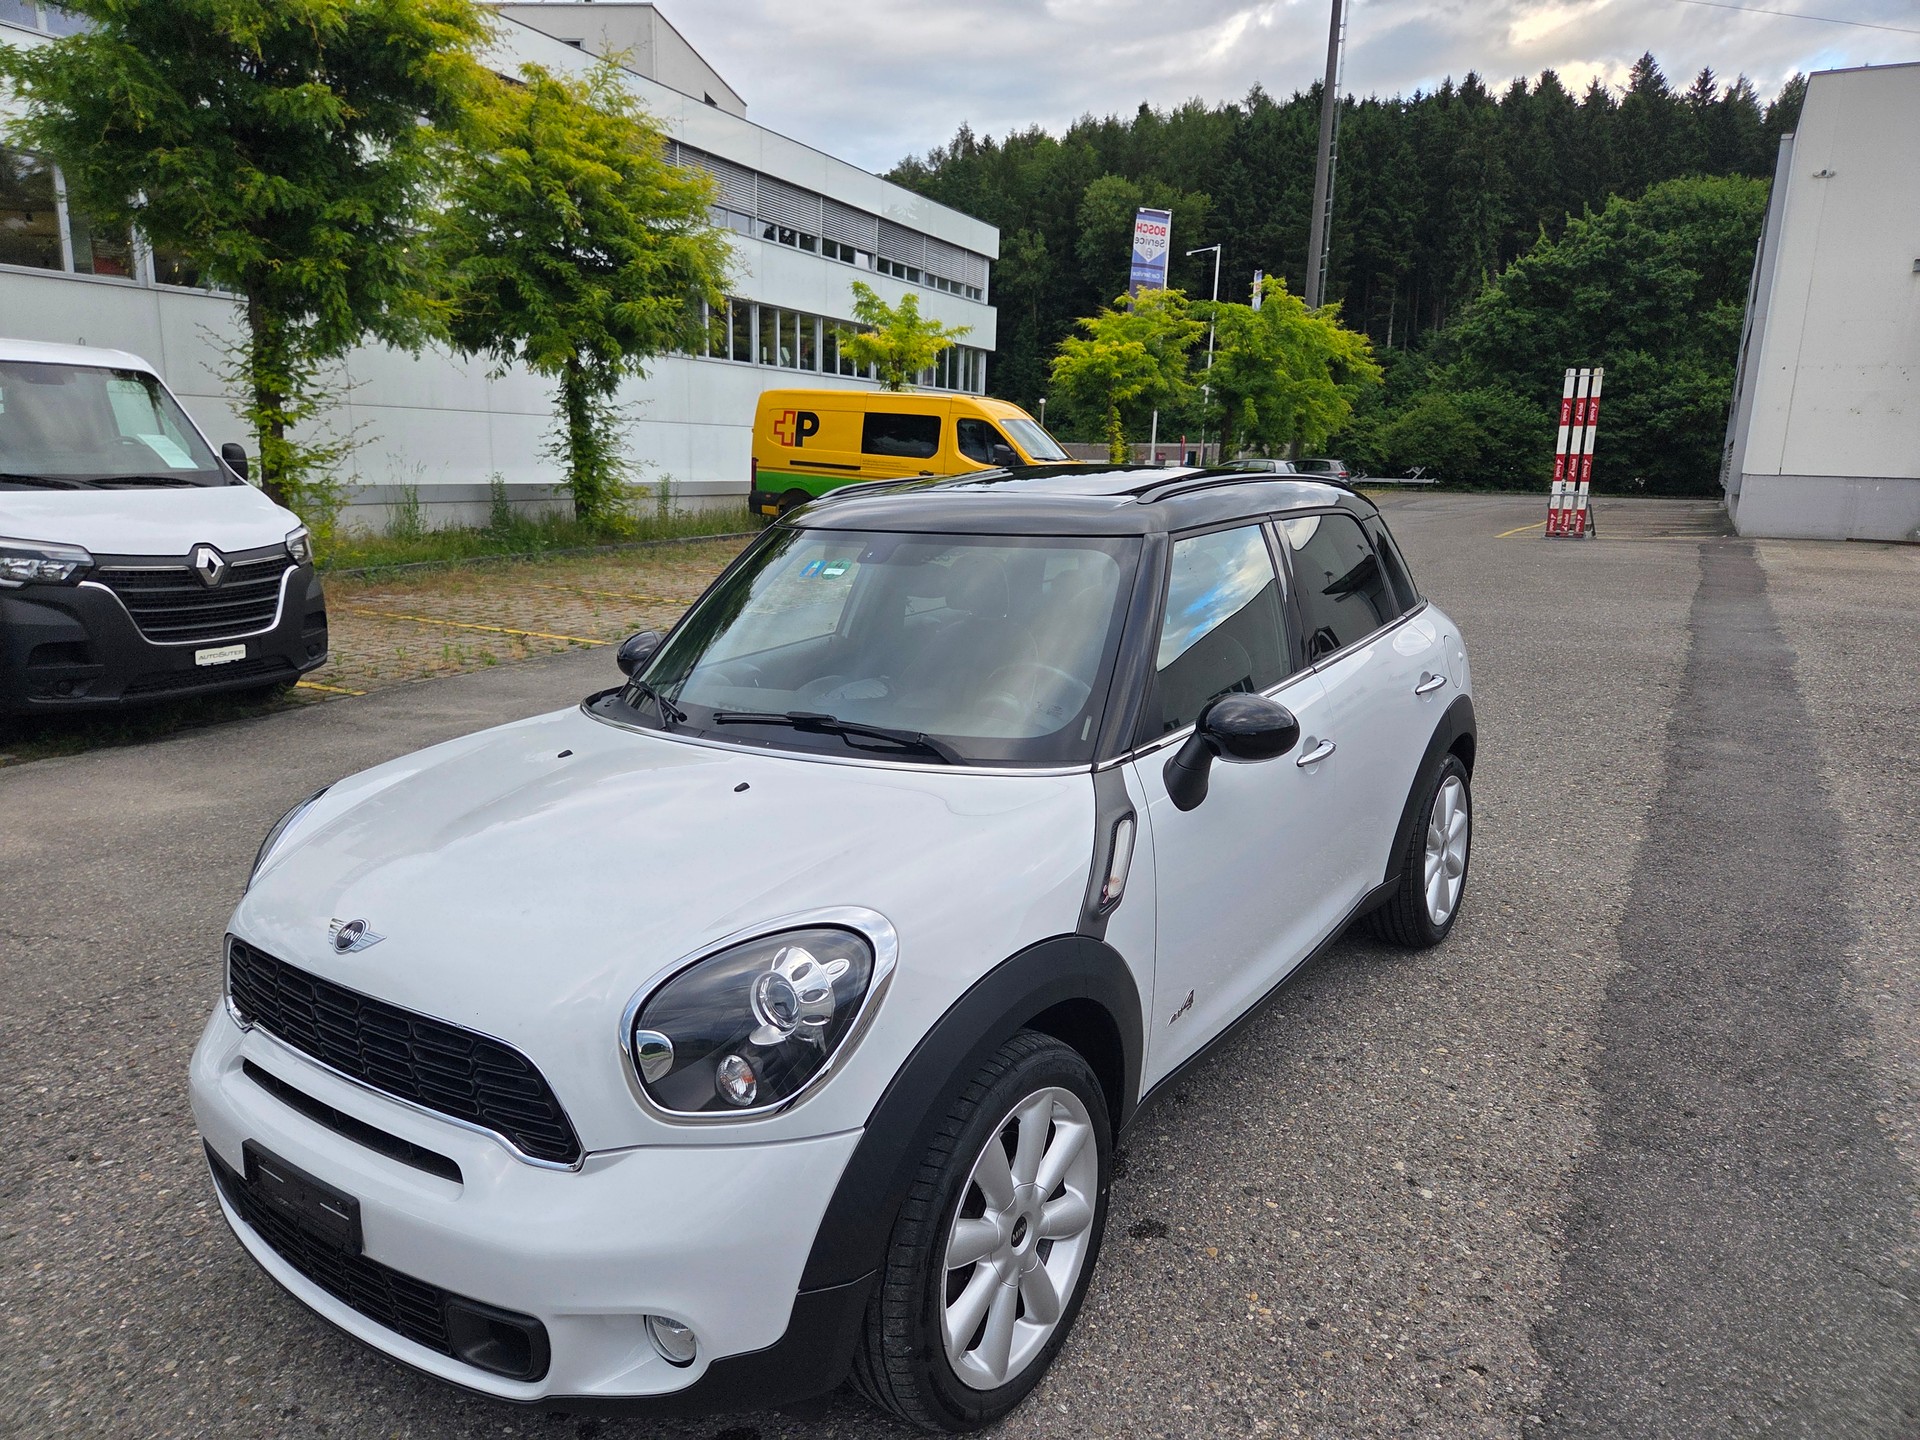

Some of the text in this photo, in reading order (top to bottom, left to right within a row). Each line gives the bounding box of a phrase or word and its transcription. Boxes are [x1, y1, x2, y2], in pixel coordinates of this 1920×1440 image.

[794, 410, 820, 447] P
[340, 928, 361, 942] MINI
[1012, 1221, 1027, 1243] MINI
